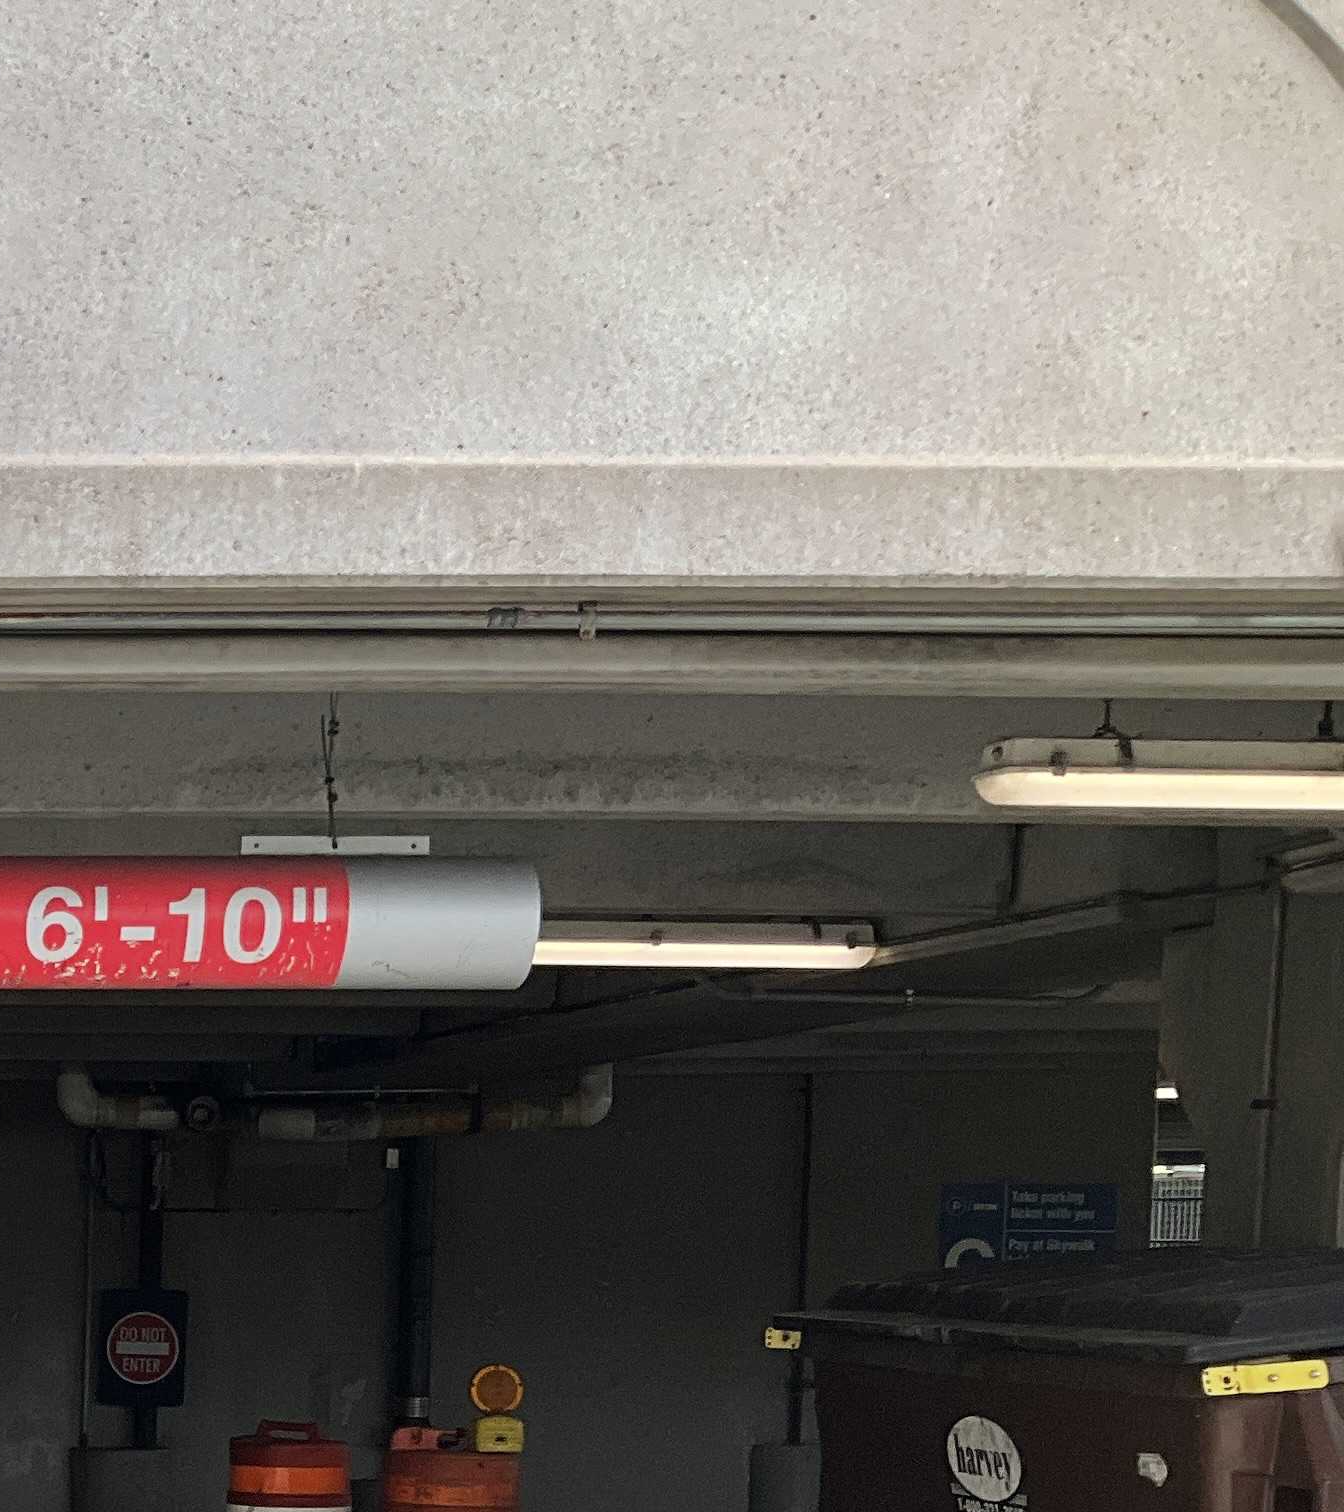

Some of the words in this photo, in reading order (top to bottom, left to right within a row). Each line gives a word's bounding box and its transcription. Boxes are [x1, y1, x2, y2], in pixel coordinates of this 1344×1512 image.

[24, 885, 329, 965] 6'-10"
[120, 1326, 139, 1342] DO
[142, 1326, 166, 1342] NOT
[123, 1358, 161, 1373] ENTER
[954, 1433, 1011, 1491] harvey
